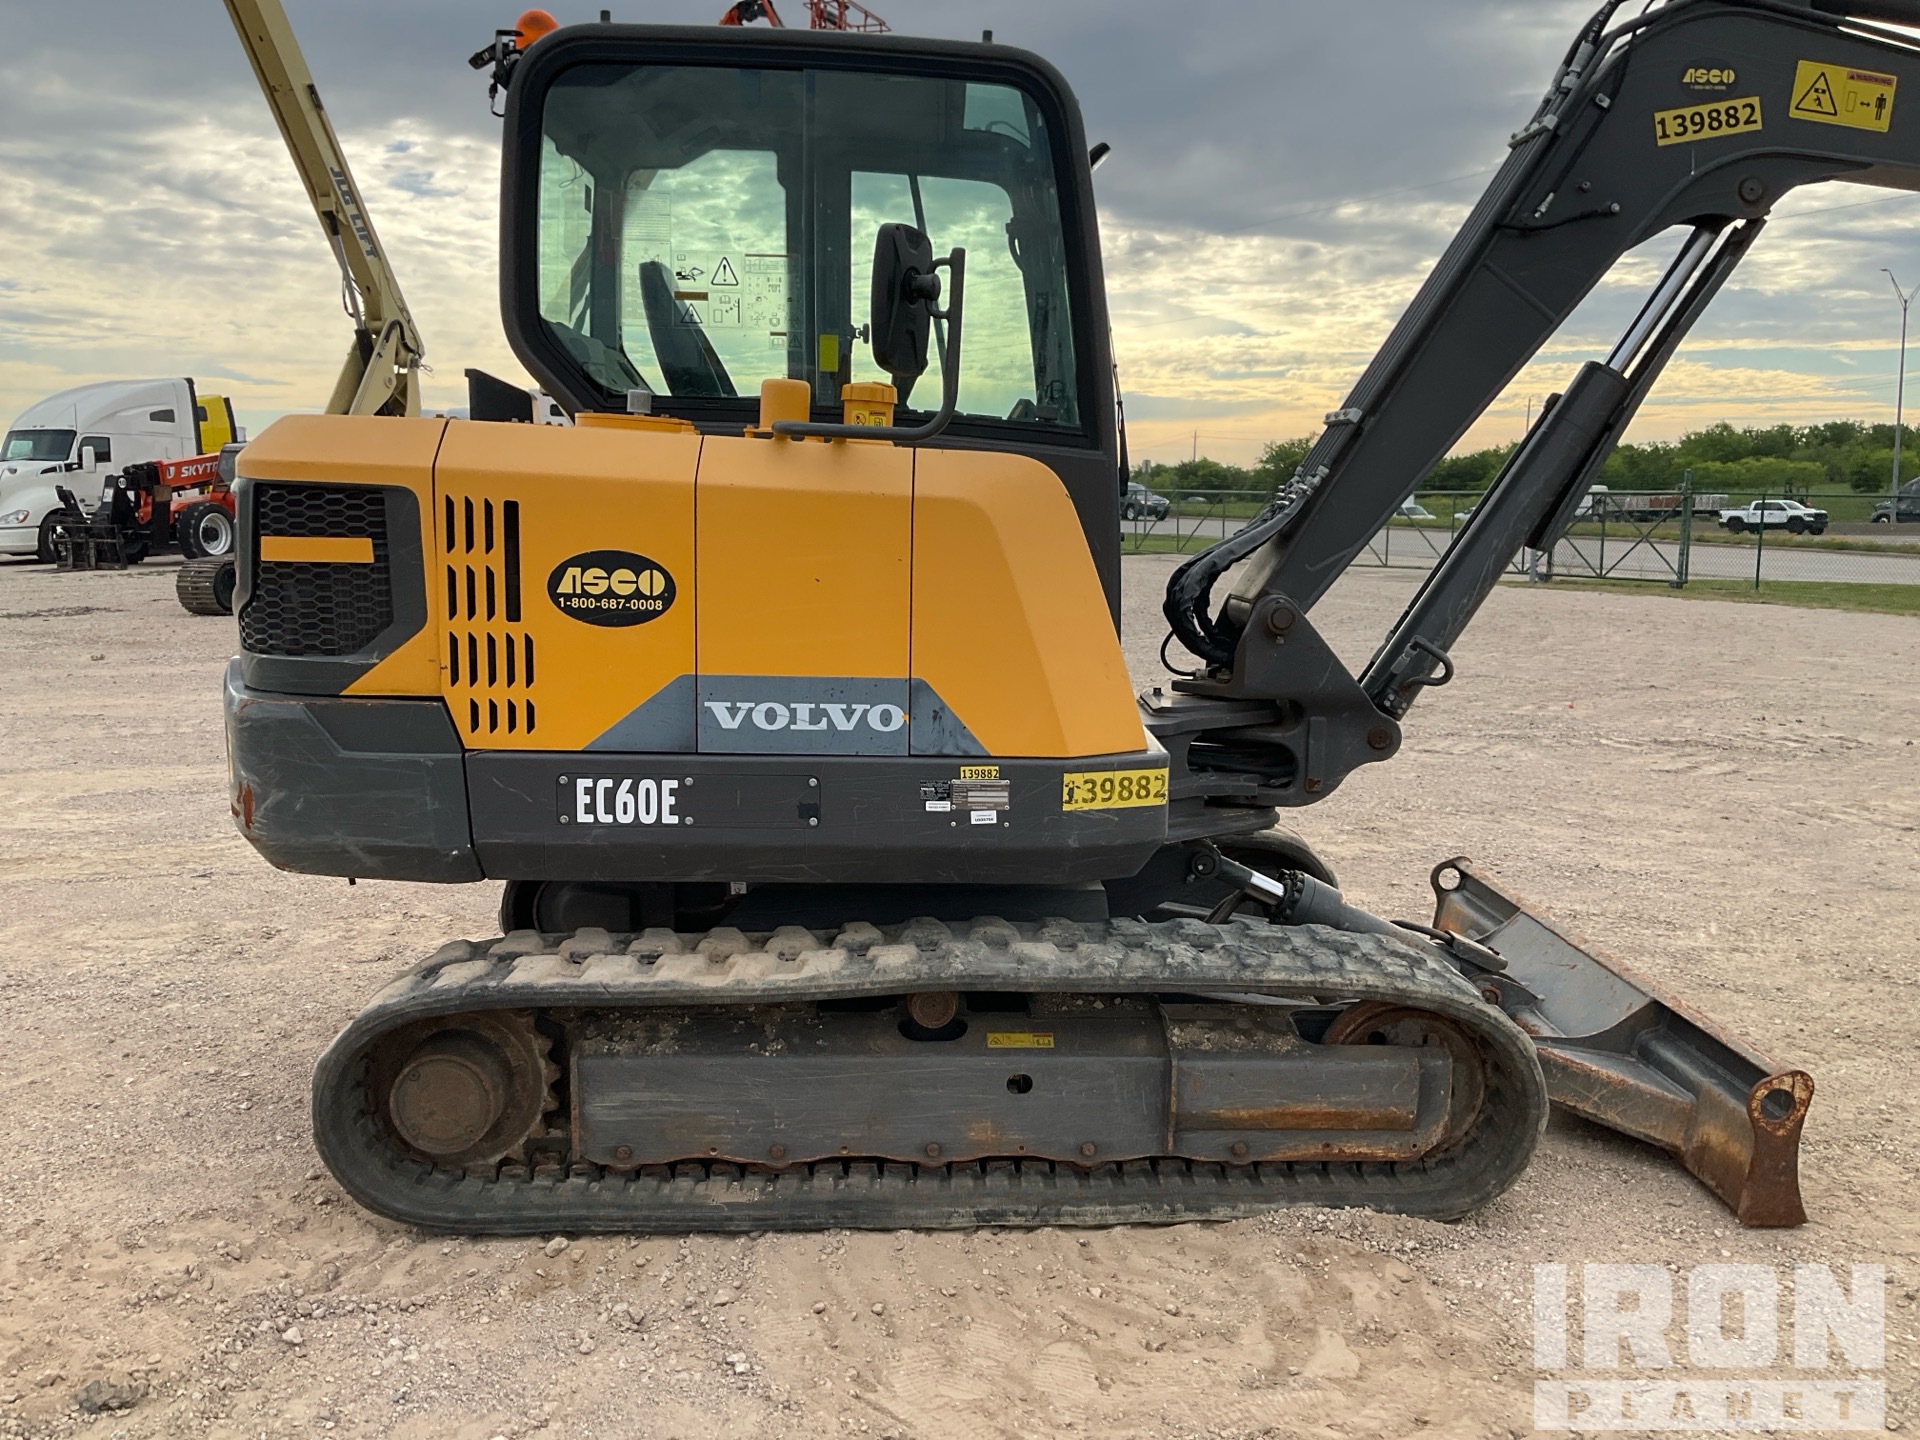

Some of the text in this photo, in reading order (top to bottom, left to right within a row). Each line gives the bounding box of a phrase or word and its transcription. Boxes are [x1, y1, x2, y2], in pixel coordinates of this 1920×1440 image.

[1682, 68, 1736, 84] ASCO
[1656, 102, 1758, 140] 139882
[329, 166, 378, 258] JLG LIFT
[556, 567, 666, 597] ASCO
[558, 597, 663, 611] 1-800-687-0008
[704, 701, 906, 732] VOLVO
[962, 768, 999, 779] 139882
[1062, 773, 1168, 805] 139882
[576, 778, 679, 825] EC60E
